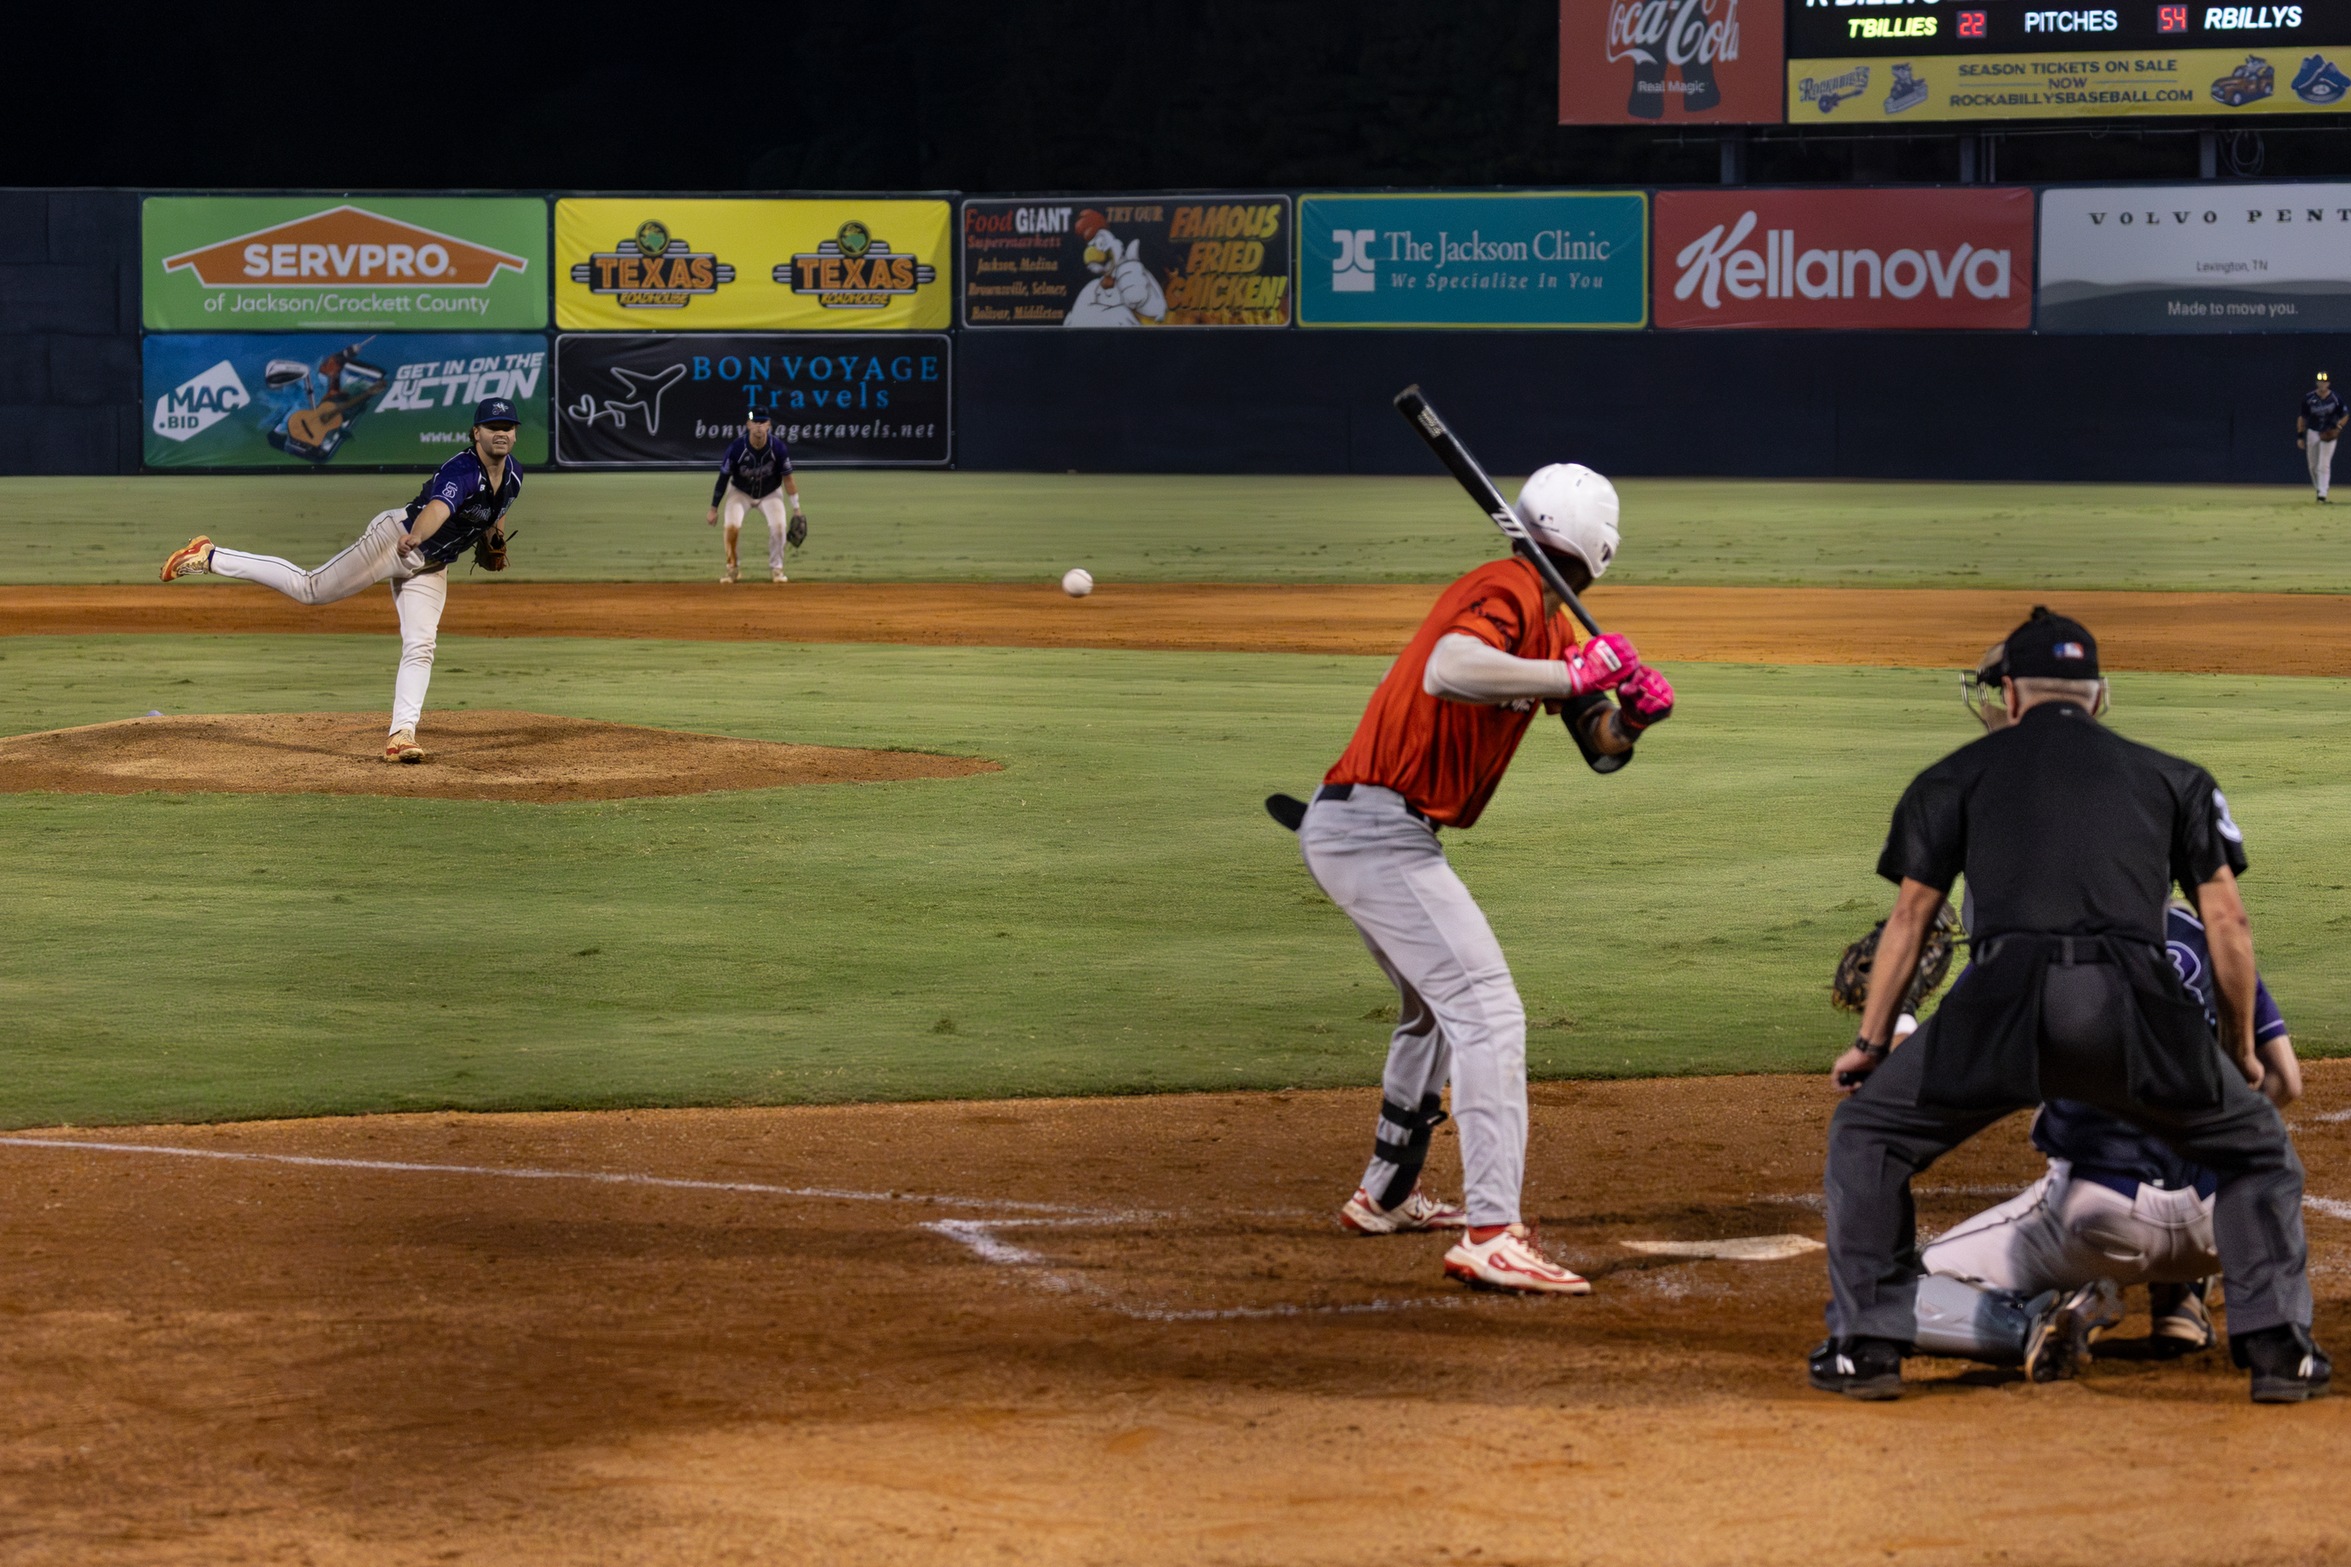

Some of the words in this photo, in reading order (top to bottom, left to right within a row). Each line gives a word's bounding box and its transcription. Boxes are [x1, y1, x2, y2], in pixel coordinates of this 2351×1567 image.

[1959, 13, 1985, 36] 22
[2024, 10, 2118, 33] PITCHES
[2159, 8, 2187, 29] 54
[2203, 7, 2303, 30] RBILLYS
[1958, 64, 2026, 76] SEASON
[2031, 61, 2100, 74] TICKETS
[2105, 61, 2129, 73] ON
[2135, 59, 2178, 72] SALE
[1637, 80, 1666, 93] Real
[1668, 80, 1705, 95] Magic
[2048, 77, 2088, 89] NOW
[1950, 89, 2193, 108] ROCKABILLYSBASEBALL.COM
[965, 208, 1014, 233] Food
[1106, 206, 1132, 222] TRY
[1134, 206, 1164, 222] OUR
[1169, 205, 1281, 239] FAMOUS
[2089, 210, 2218, 226] VOLVO
[967, 236, 1062, 251] Supermarkets
[1384, 231, 1433, 261] The
[1435, 230, 1529, 269] Jackson
[1533, 230, 1611, 261] Clinic
[1185, 240, 1265, 274] FRIED
[1674, 210, 2011, 309] Kellanova
[2251, 260, 2268, 272] TN
[595, 257, 714, 290] TEXAS
[797, 258, 914, 290] TEXAS
[1391, 273, 1417, 289] We
[1425, 272, 1529, 292] Specialize
[1538, 273, 1557, 288] In
[1569, 273, 1603, 289] You
[204, 293, 225, 313] of
[230, 293, 411, 315] Jackson/Crockett
[416, 293, 490, 316] County
[1164, 275, 1288, 310] CHICKEN!
[2167, 301, 2207, 316] Made
[2210, 302, 2224, 316] to
[2227, 304, 2265, 315] move
[2268, 303, 2299, 319] you.
[396, 362, 440, 380] GET
[442, 360, 465, 375] IN
[469, 356, 500, 374] ON
[505, 352, 545, 369] THE
[167, 386, 239, 413] MAC
[742, 381, 890, 409] Travels
